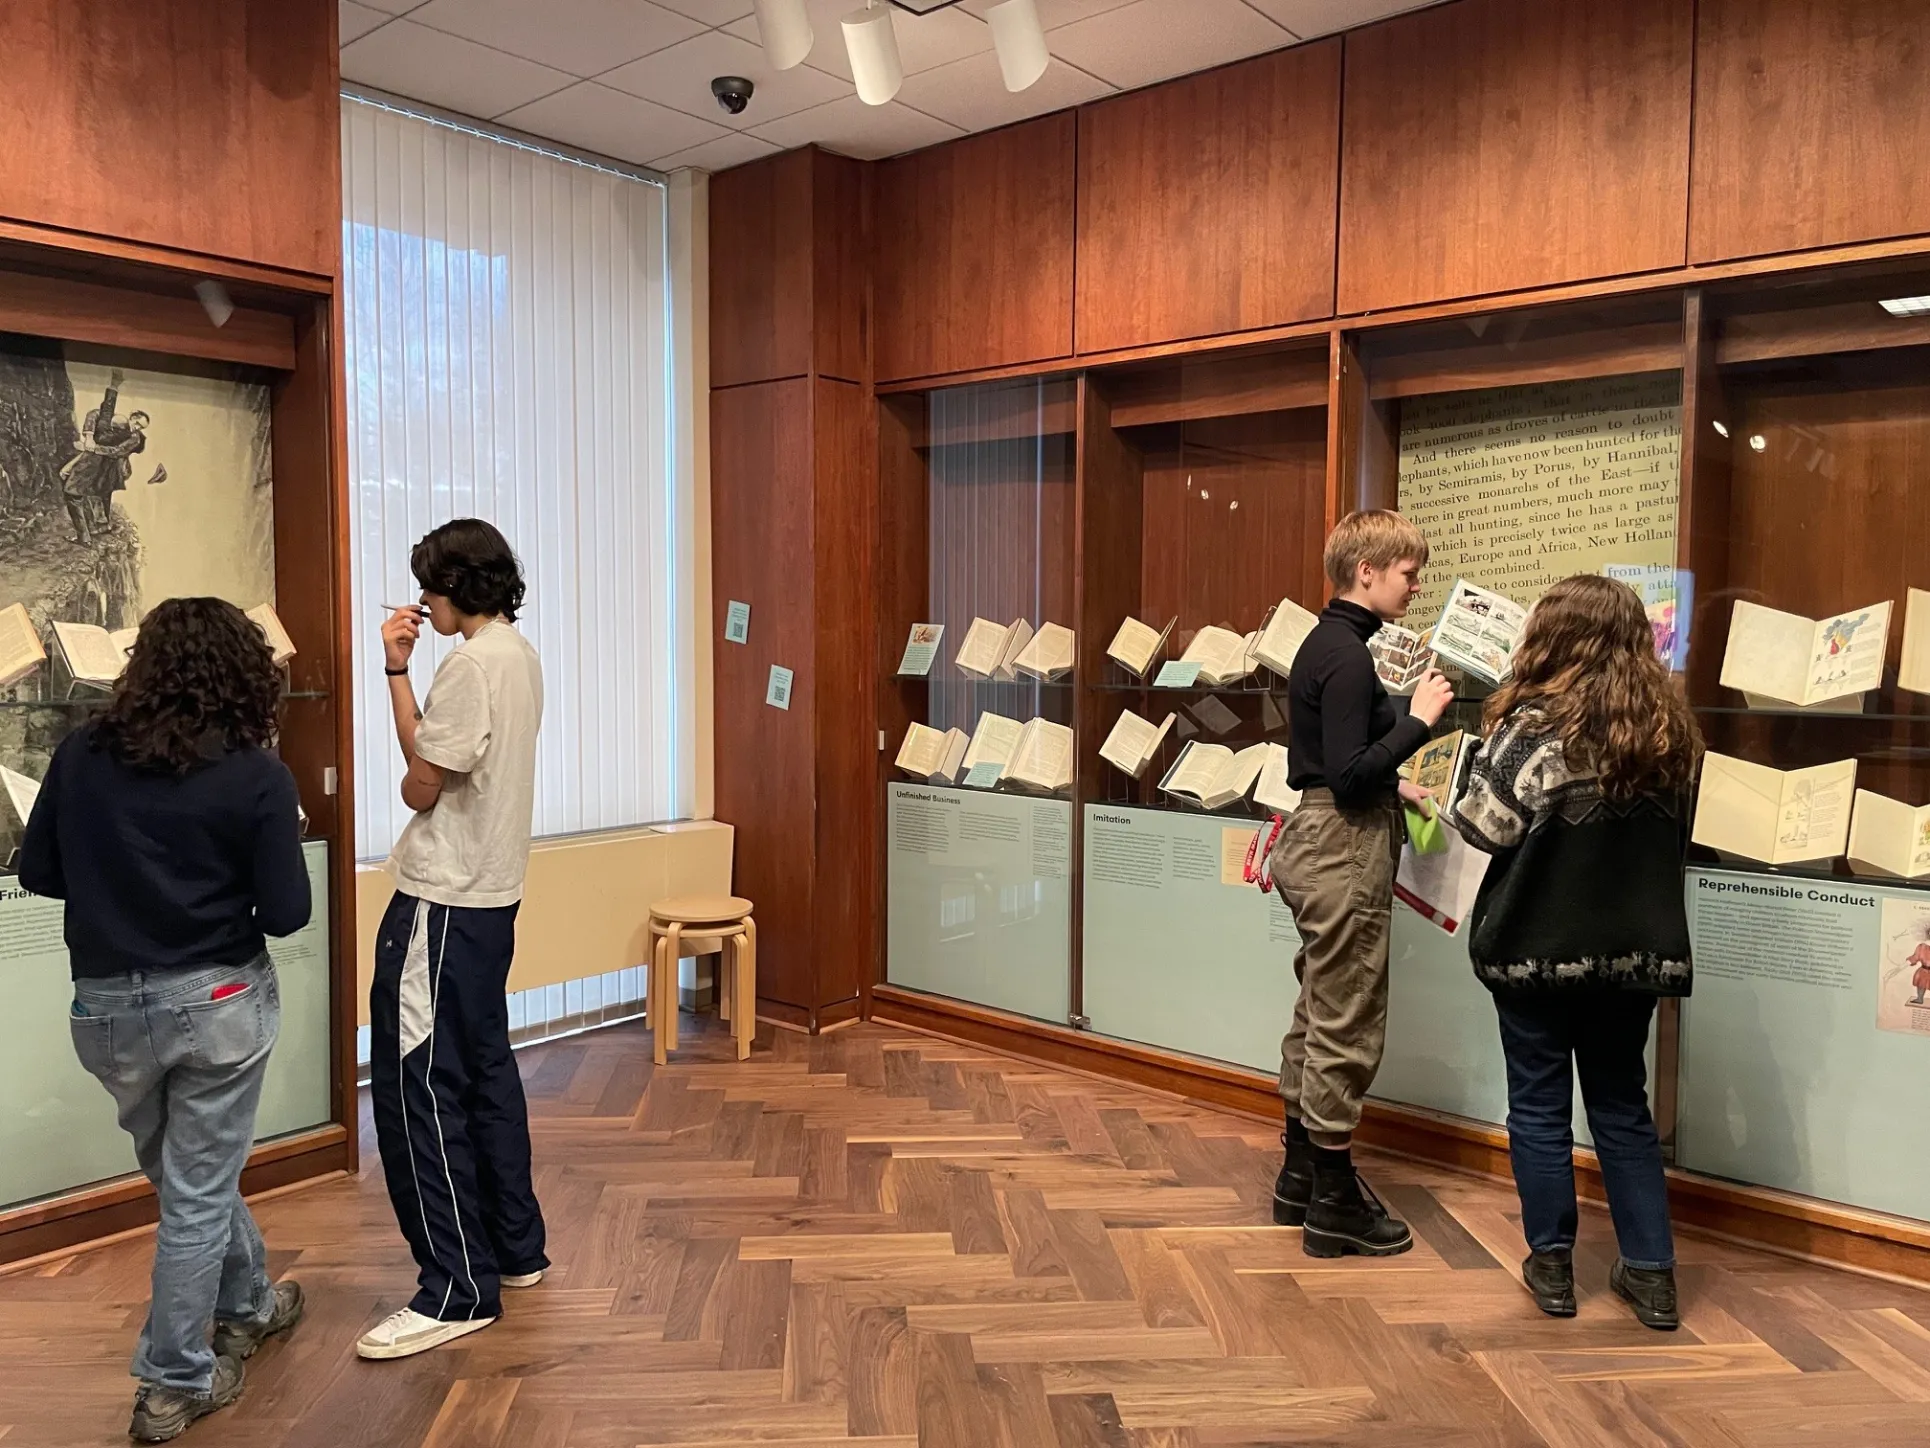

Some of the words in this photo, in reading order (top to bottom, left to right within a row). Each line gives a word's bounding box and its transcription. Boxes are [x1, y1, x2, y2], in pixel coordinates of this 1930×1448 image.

[1402, 441, 1420, 451] are
[1424, 429, 1483, 447] numerous
[1488, 425, 1501, 436] as
[1505, 418, 1548, 432] droves
[1552, 411, 1567, 423] of
[1413, 451, 1436, 465] And
[1445, 446, 1476, 458] there
[1484, 438, 1521, 452] seems
[1530, 433, 1546, 443] no
[1555, 425, 1598, 439] reason
[1608, 420, 1623, 430] to
[1632, 410, 1674, 426] doubt
[1453, 458, 1489, 472] which
[1492, 454, 1521, 467] have
[1523, 448, 1550, 461] now
[1554, 444, 1583, 456] been
[1586, 432, 1635, 450] hunted
[1640, 429, 1660, 441] for
[1419, 484, 1434, 496] by
[1438, 472, 1506, 491] Semiramis,
[1512, 467, 1529, 479] by
[1533, 462, 1575, 475] Porus,
[1583, 456, 1600, 468] by
[1607, 442, 1677, 463] Hannibal,
[1409, 513, 1439, 525] there
[1443, 510, 1454, 521] in
[1457, 505, 1489, 520] great
[1493, 498, 1552, 513] numbers,
[1557, 489, 1593, 503] much
[1599, 485, 1634, 497] more
[1639, 479, 1670, 491] may
[1410, 493, 1470, 510] successive
[1478, 483, 1539, 499] monarchs
[1547, 477, 1560, 488] of
[1569, 474, 1591, 486] the
[1432, 538, 1467, 552] which
[1474, 536, 1484, 546] is
[1490, 528, 1544, 547] precisely
[1552, 523, 1586, 537] twice
[1593, 521, 1608, 531] as
[1615, 517, 1651, 528] large
[1658, 513, 1673, 522] as
[1449, 523, 1463, 535] all
[1470, 517, 1523, 533] hunting,
[1528, 512, 1560, 523] since
[1567, 507, 1583, 518] he
[1589, 504, 1613, 515] has
[1620, 503, 1628, 511] a
[1459, 550, 1504, 564] Europe
[1508, 545, 1532, 557] and
[1538, 541, 1582, 554] Africa,
[1587, 535, 1619, 548] New
[1433, 571, 1452, 582] the
[1456, 570, 1475, 579] sea
[1480, 560, 1545, 577] combined.
[1494, 580, 1507, 590] to
[1608, 566, 1641, 578] from
[1647, 562, 1671, 574] the
[896, 790, 931, 801] Unfinished
[933, 794, 960, 804] Business
[1093, 813, 1131, 825] Imitation
[1698, 877, 1803, 900] Reprehensible
[1808, 890, 1876, 908] Conduct
